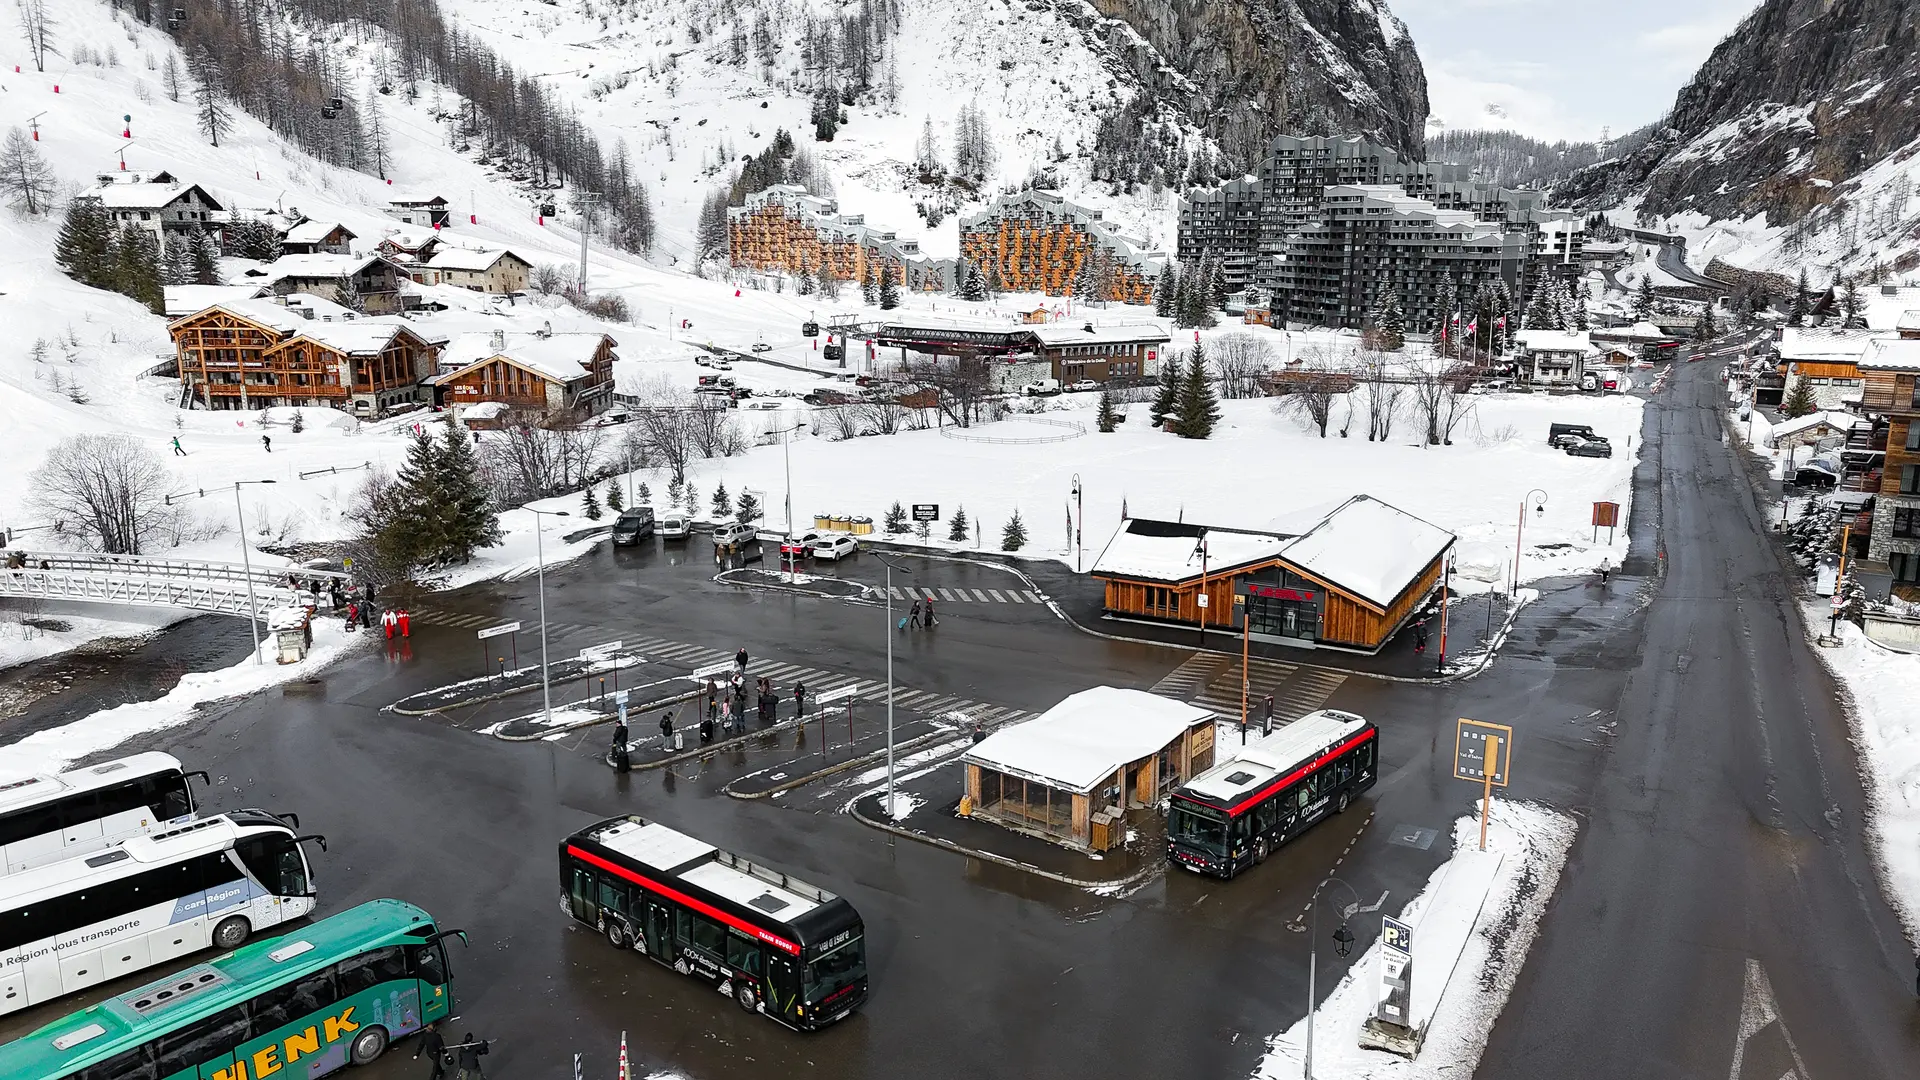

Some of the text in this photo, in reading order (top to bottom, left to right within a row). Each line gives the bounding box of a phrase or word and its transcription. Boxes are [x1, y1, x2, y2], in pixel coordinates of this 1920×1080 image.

[184, 888, 240, 911] cars Région
[6, 948, 49, 967] Région
[51, 938, 79, 952] vous
[81, 920, 140, 942] transporte
